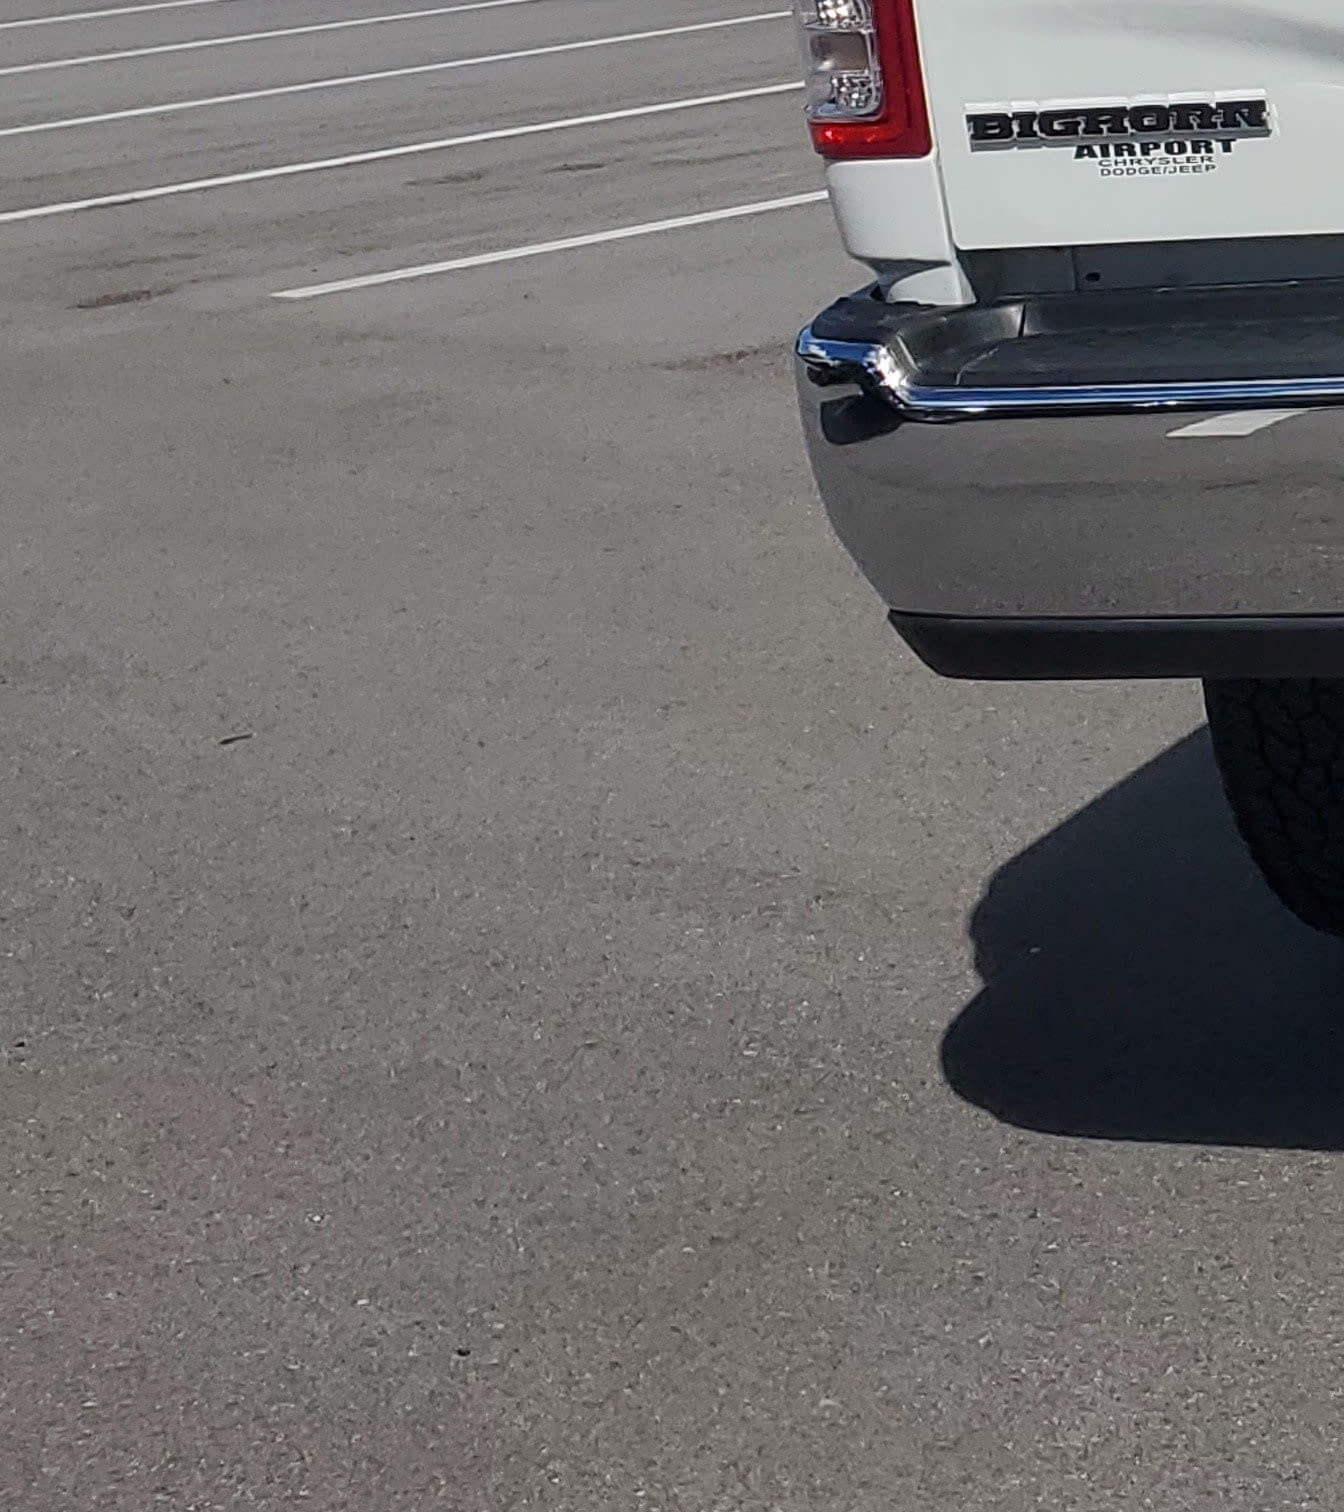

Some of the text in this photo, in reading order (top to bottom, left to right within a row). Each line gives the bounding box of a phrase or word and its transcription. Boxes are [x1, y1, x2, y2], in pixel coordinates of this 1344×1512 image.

[965, 99, 1272, 152] BIGHORN
[1074, 138, 1237, 159] AIRPORT
[1098, 155, 1215, 167] CHRYSLER
[1100, 164, 1217, 177] DODGE/JEEP
